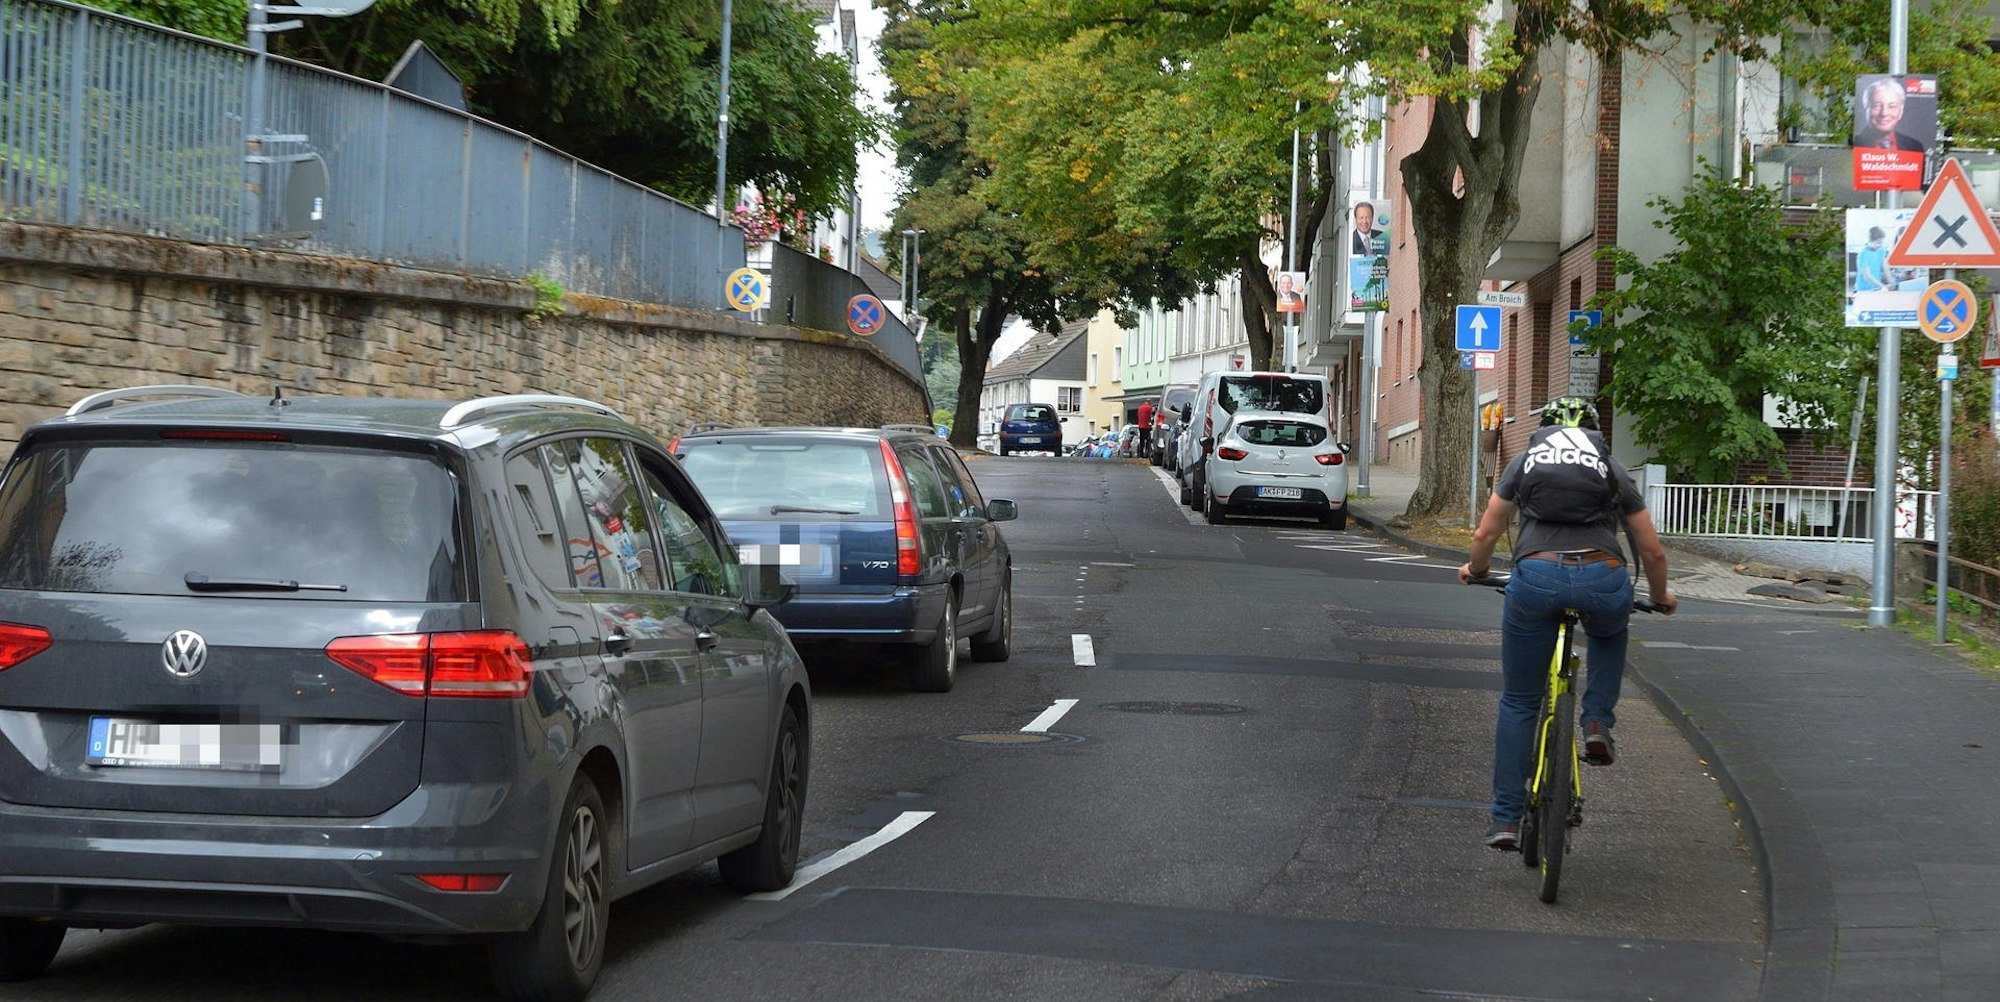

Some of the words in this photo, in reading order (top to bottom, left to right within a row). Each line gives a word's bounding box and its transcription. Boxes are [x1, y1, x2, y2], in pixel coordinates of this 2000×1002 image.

[1861, 153, 1886, 161] Klaus
[1887, 153, 1899, 161] W.
[1861, 162, 1919, 171] Waldschmidt
[1485, 293, 1498, 301] Am
[1499, 294, 1522, 303] Broich
[1524, 448, 1608, 479] adidas
